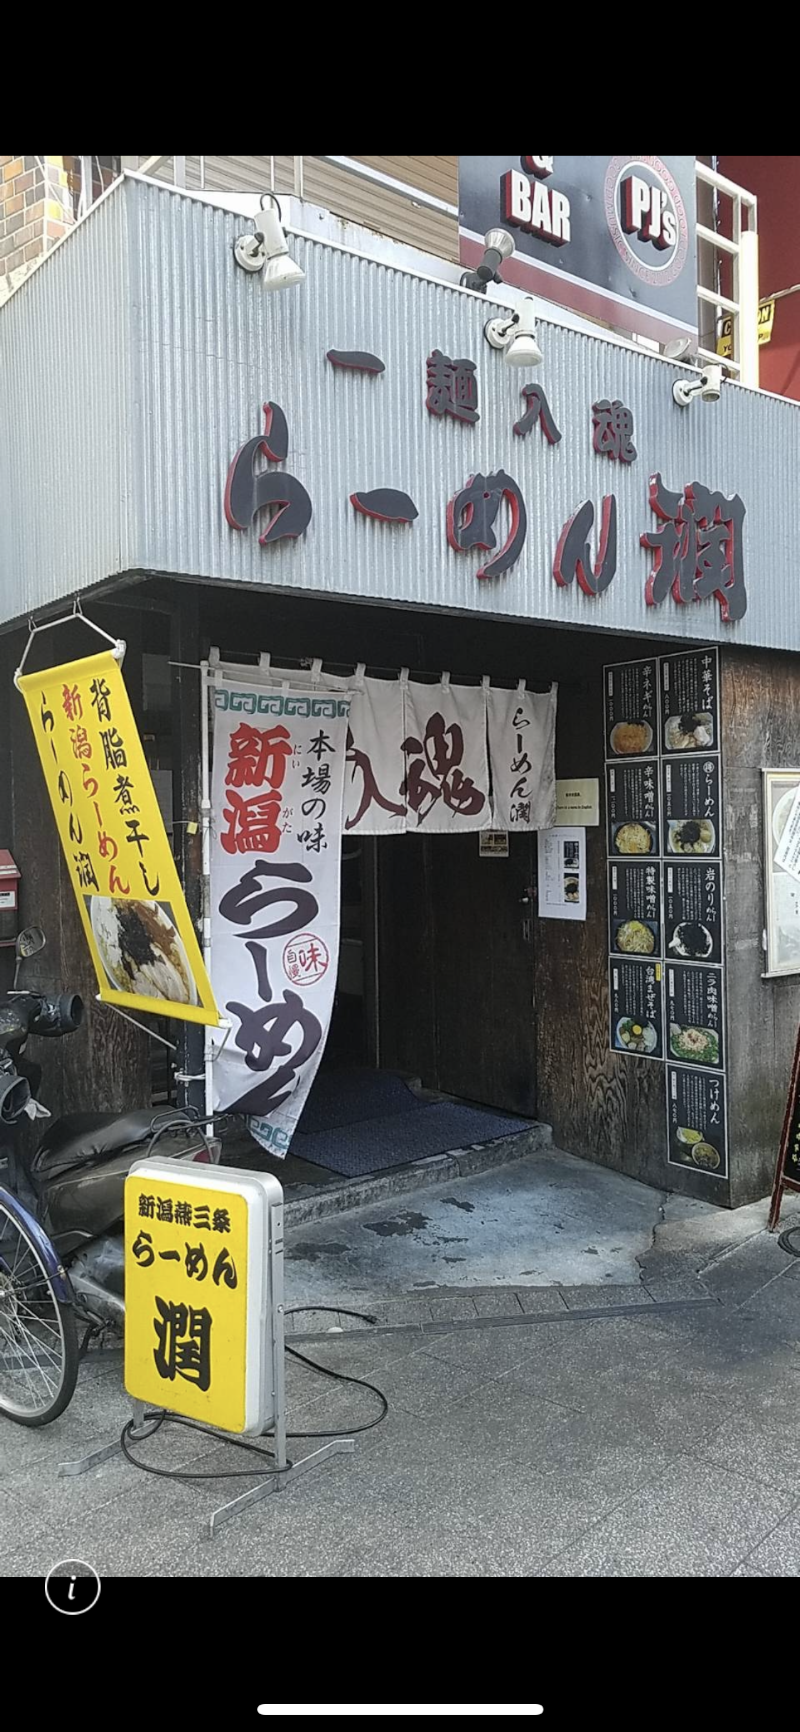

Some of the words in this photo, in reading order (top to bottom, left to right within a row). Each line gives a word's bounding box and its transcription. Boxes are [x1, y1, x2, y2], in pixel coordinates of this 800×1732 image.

[504, 169, 571, 246] BAR
[327, 349, 637, 463] 一麺入魂
[224, 401, 748, 622] らーめん潤
[701, 655, 713, 710] 中華そば
[40, 690, 99, 892] らーめん潤
[62, 683, 131, 895] 新潟らーめん
[89, 678, 159, 897] 背脂煮干し
[297, 729, 336, 854] 本場の味
[509, 707, 532, 824] らーめん潤
[708, 1079, 720, 1125] つけめん
[132, 1229, 238, 1290] らーめん
[138, 1193, 231, 1234] 新潟燕三条
[153, 1295, 212, 1392] 潤
